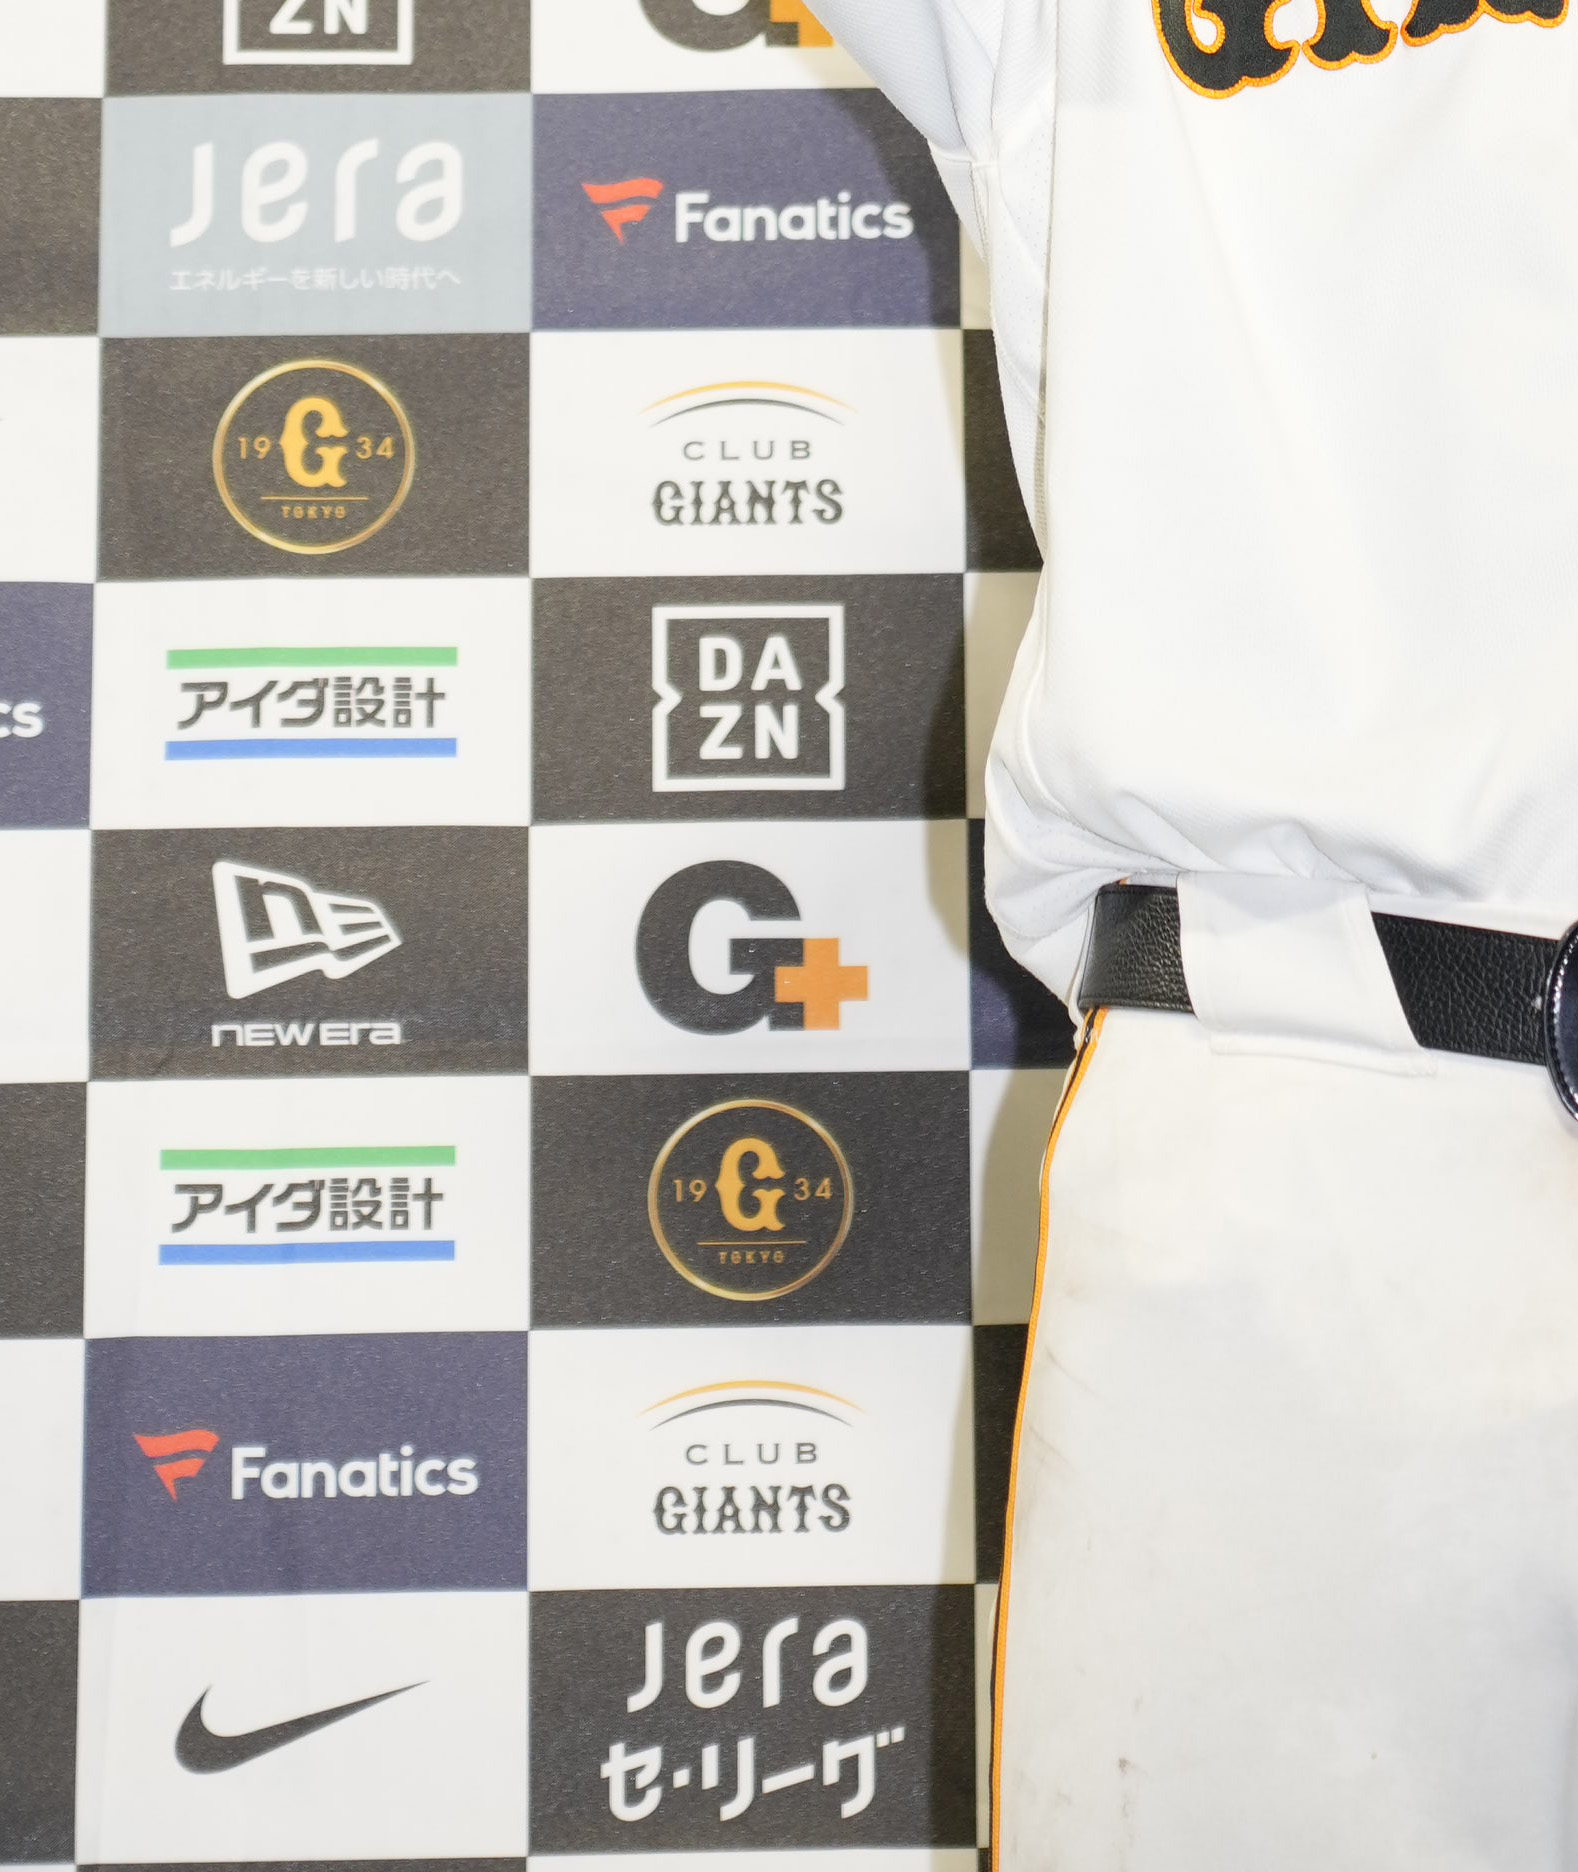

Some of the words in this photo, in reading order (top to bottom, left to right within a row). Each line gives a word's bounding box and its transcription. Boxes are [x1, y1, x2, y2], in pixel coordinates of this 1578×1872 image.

[676, 187, 916, 242] Fanatics
[239, 436, 271, 459] 19
[279, 396, 348, 487] G
[357, 436, 393, 459] 34
[683, 440, 811, 461] CLUB
[652, 479, 843, 525] GIANTS
[699, 635, 801, 691] DA
[179, 676, 445, 729] アイダ設計
[700, 703, 798, 759] ZN
[636, 860, 867, 1035] G+
[172, 1178, 443, 1232] アイダ設計
[674, 1179, 706, 1202] 19
[715, 1138, 784, 1231] G
[795, 1178, 831, 1200] 34
[232, 1445, 478, 1499] Fanatics
[685, 1442, 817, 1465] CLUB
[654, 1484, 850, 1534] GIANTS
[601, 1726, 904, 1821] セ・リーグ
